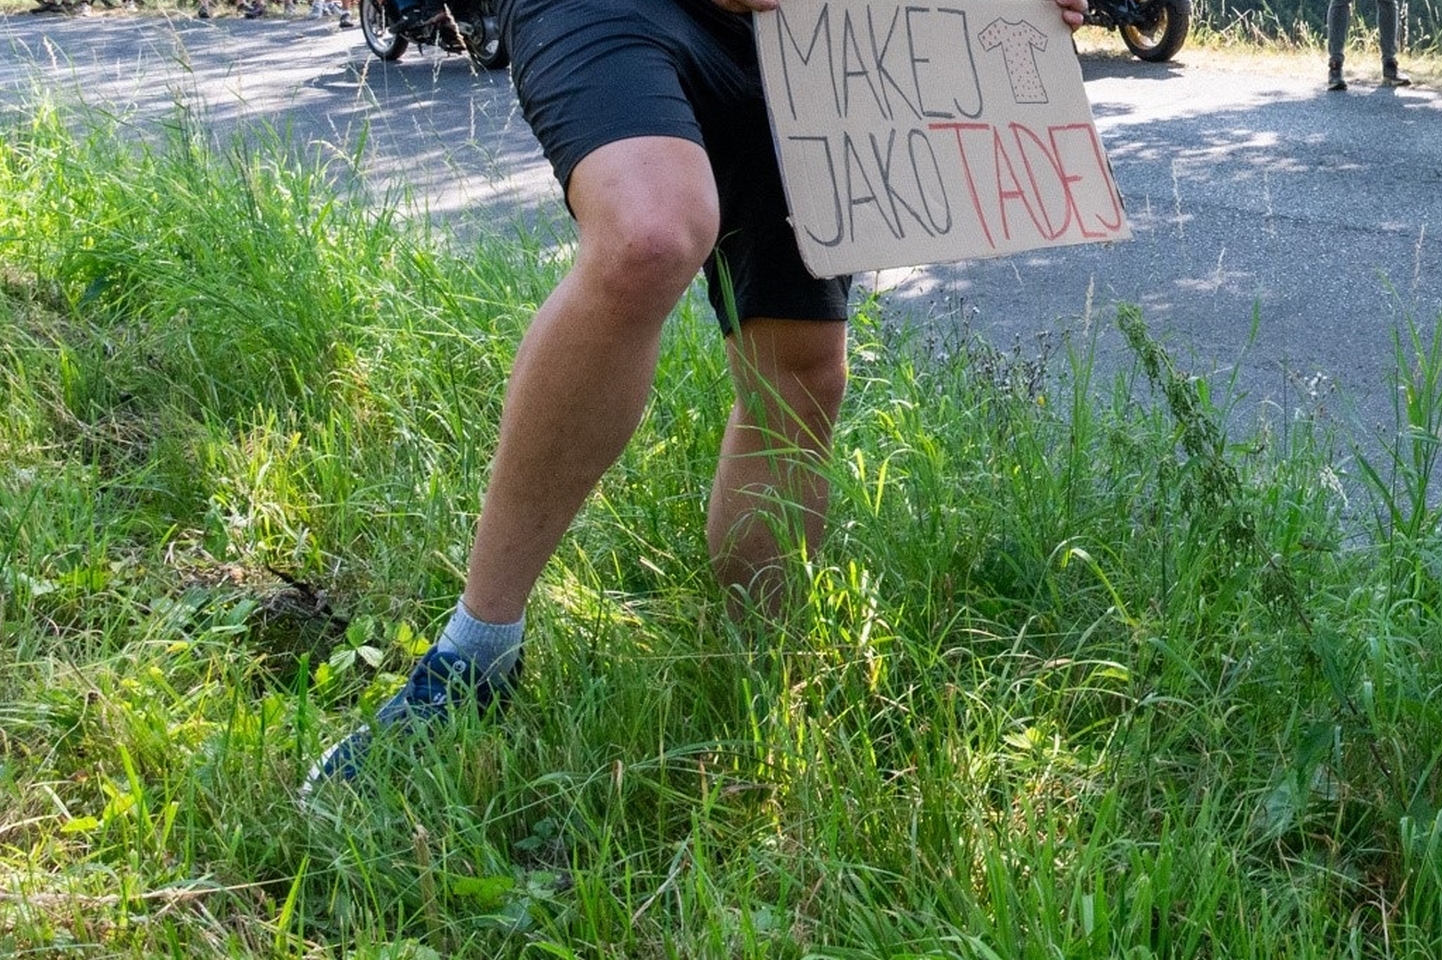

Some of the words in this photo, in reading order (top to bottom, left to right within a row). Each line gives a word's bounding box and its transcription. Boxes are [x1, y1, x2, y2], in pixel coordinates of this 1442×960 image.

[775, 2, 984, 120] MAKEJ
[787, 127, 953, 247] JAKO
[928, 121, 1122, 249] TADEJ
